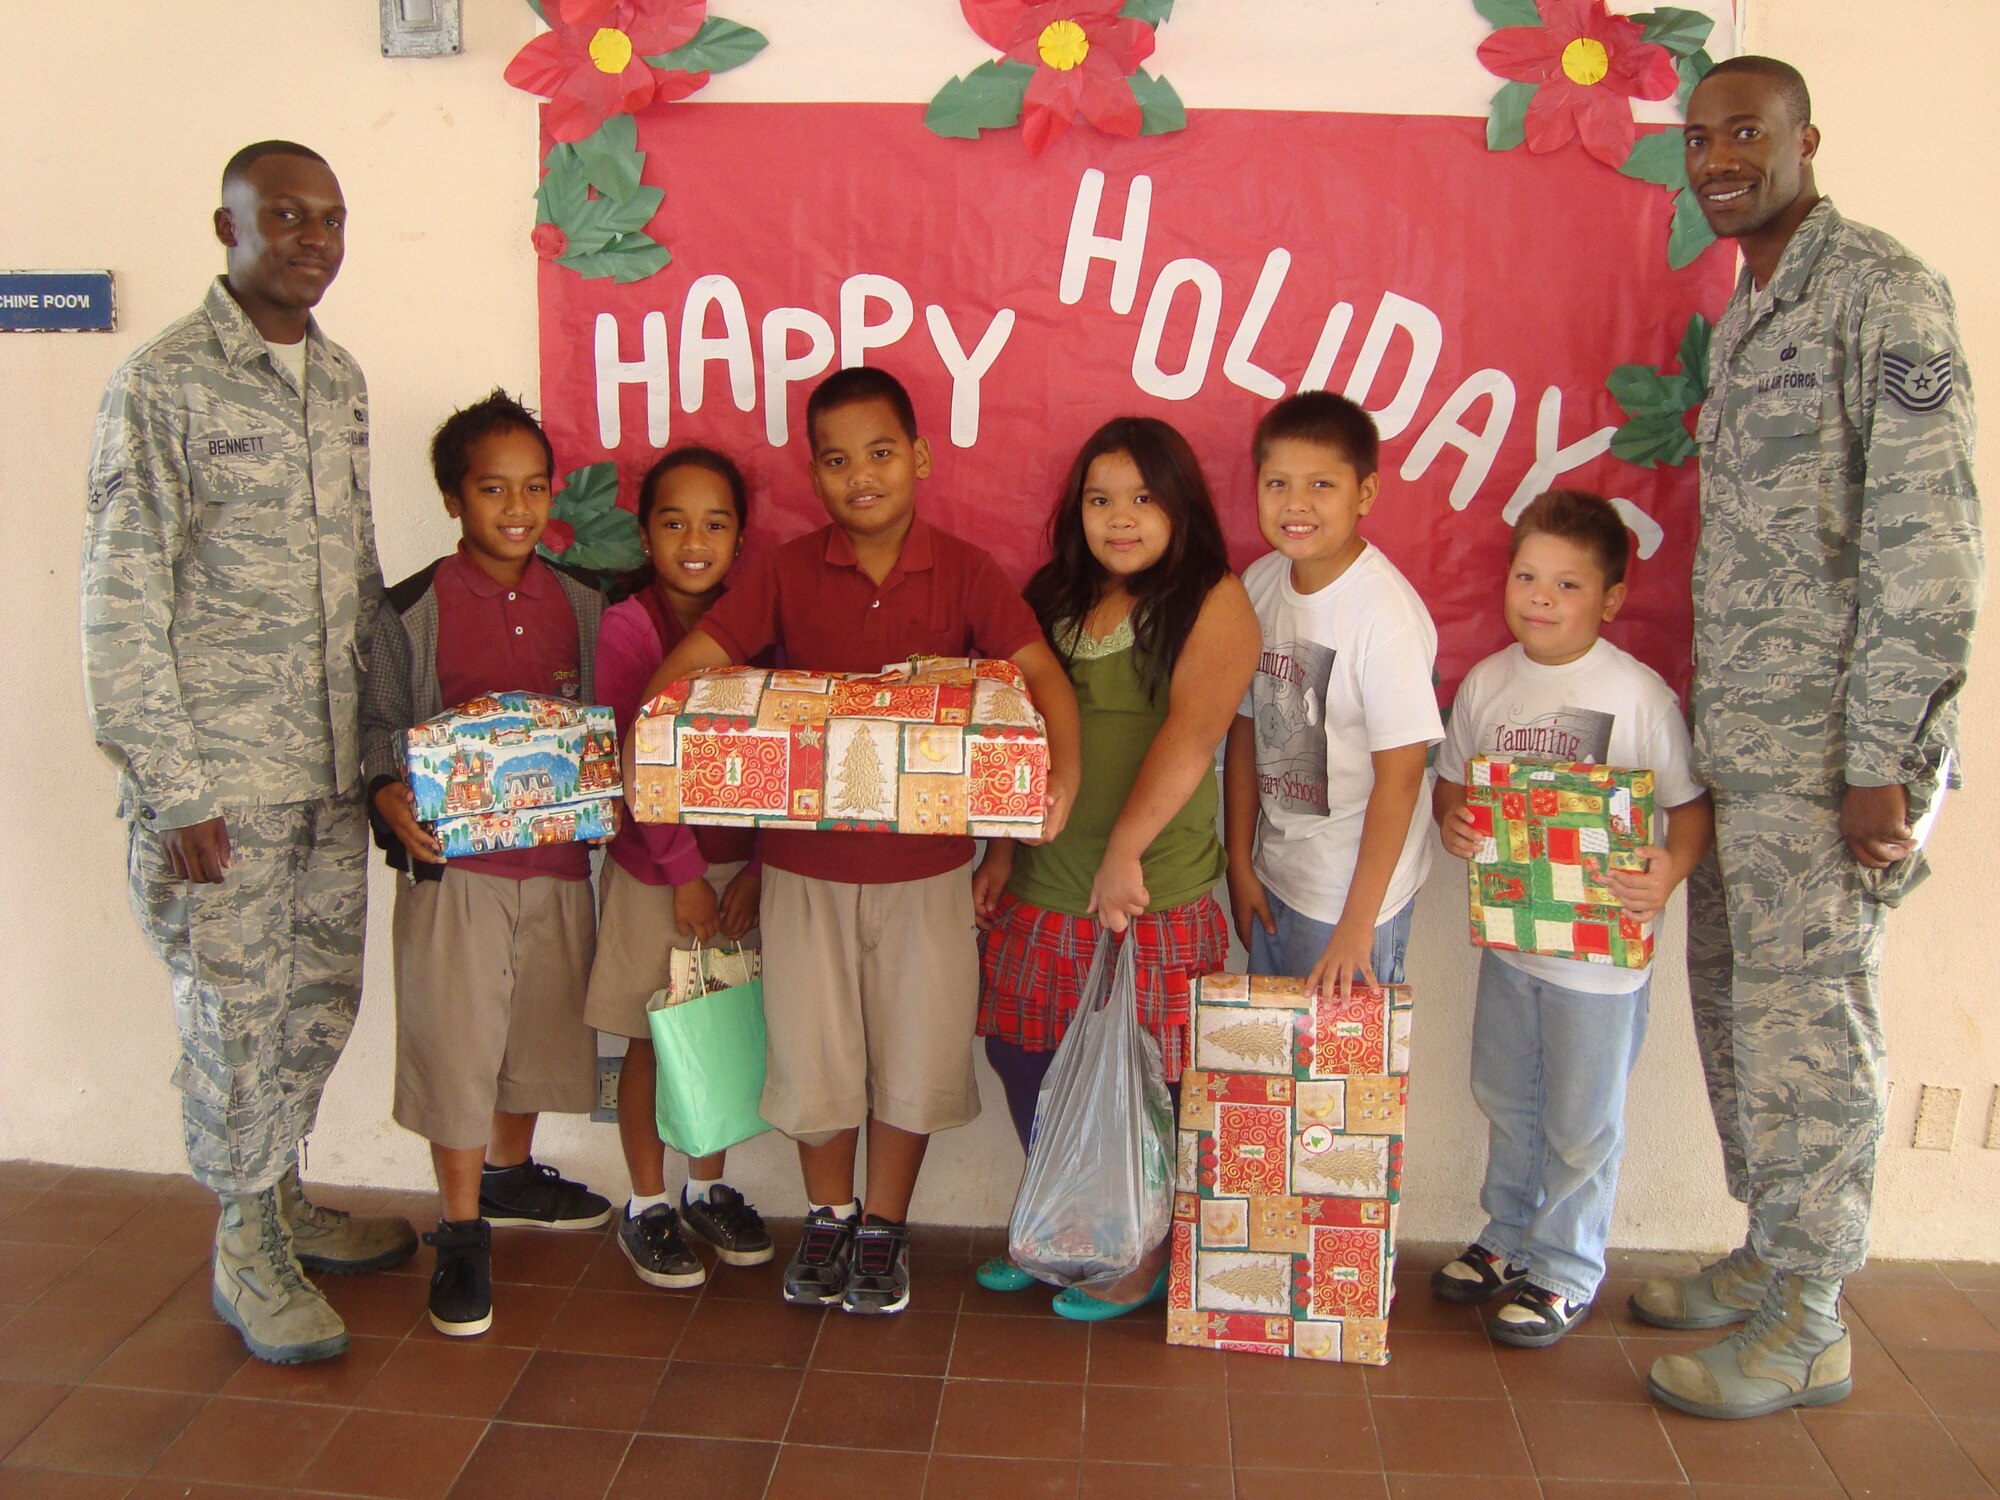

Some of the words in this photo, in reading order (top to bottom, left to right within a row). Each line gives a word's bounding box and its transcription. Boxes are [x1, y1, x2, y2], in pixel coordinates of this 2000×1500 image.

[594, 274, 1015, 450] HAPPY
[1783, 372, 1817, 389] FORCE
[208, 436, 264, 456] BENNETT
[1495, 718, 1581, 763] Tamuning
[1282, 771, 1325, 806] School
